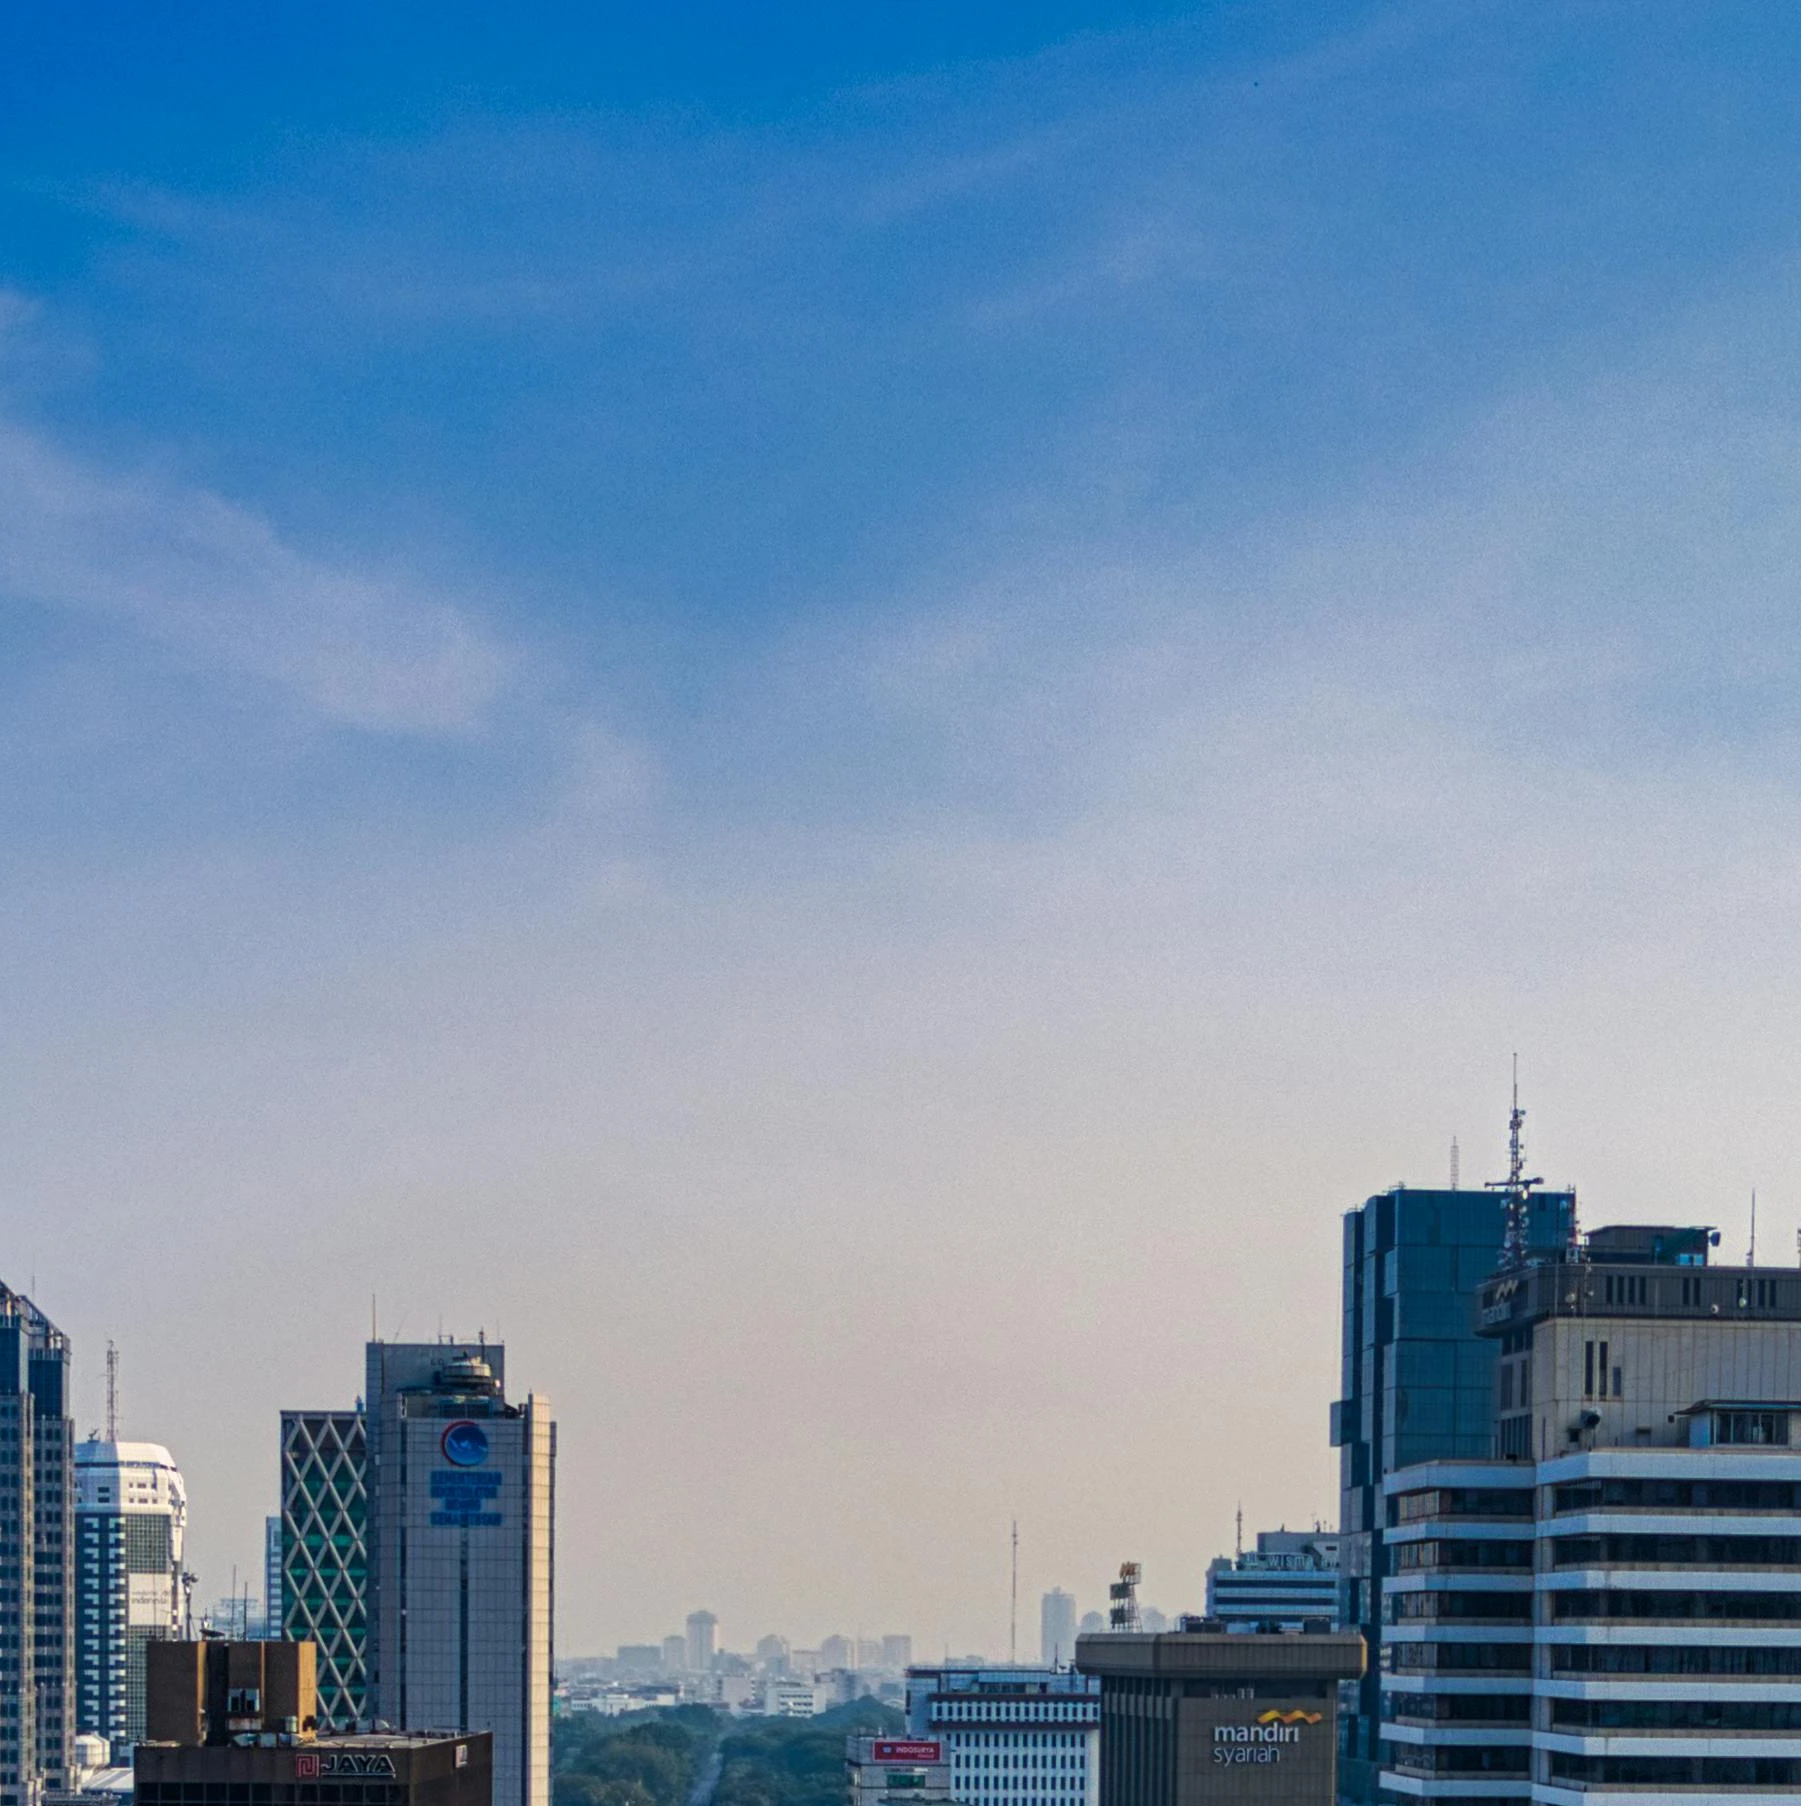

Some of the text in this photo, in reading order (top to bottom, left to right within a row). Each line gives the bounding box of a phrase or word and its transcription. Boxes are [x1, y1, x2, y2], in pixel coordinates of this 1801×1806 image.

[1214, 1722, 1300, 1742] mandiri
[321, 1754, 396, 1773] JAYA
[1214, 1745, 1280, 1767] syariah
